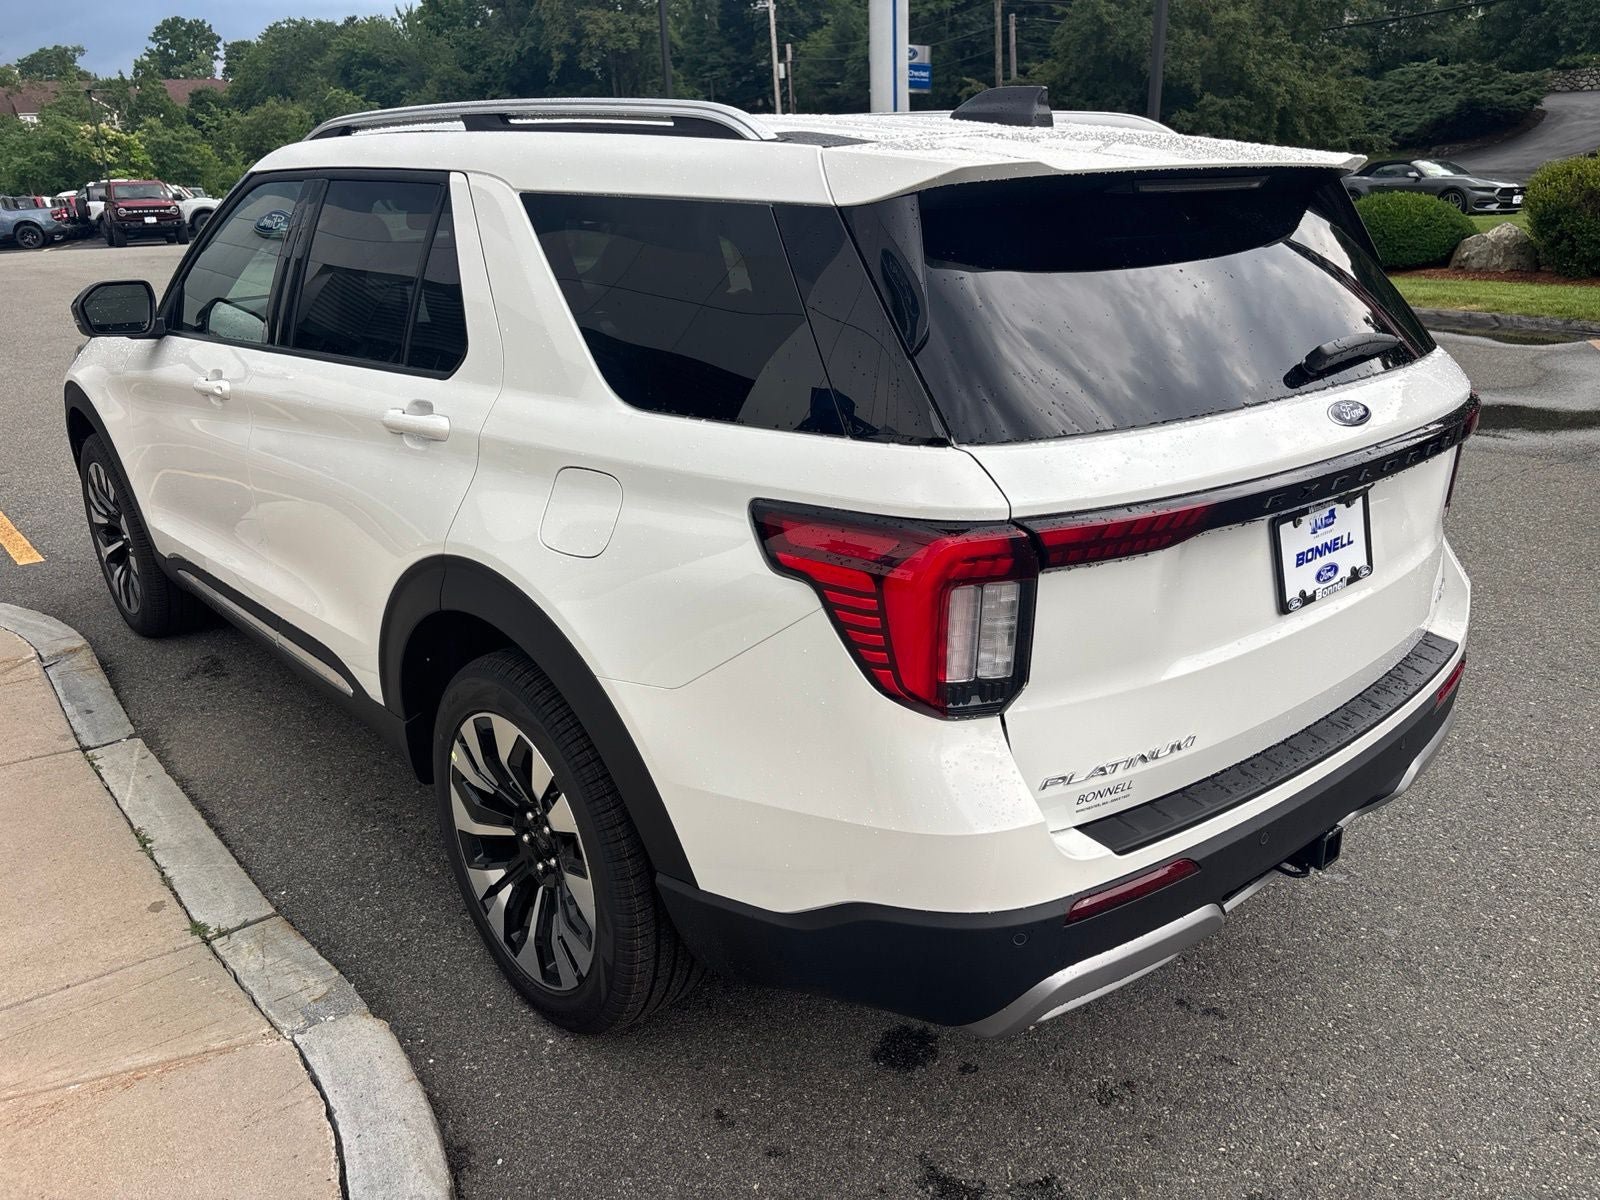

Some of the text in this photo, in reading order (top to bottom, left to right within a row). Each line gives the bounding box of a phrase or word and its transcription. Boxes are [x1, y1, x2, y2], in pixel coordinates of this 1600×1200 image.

[1295, 532, 1354, 568] BONNELL
[1315, 575, 1347, 601] Bonnell
[1039, 734, 1197, 792] PLATINUM
[1076, 780, 1133, 806] BONNELL
